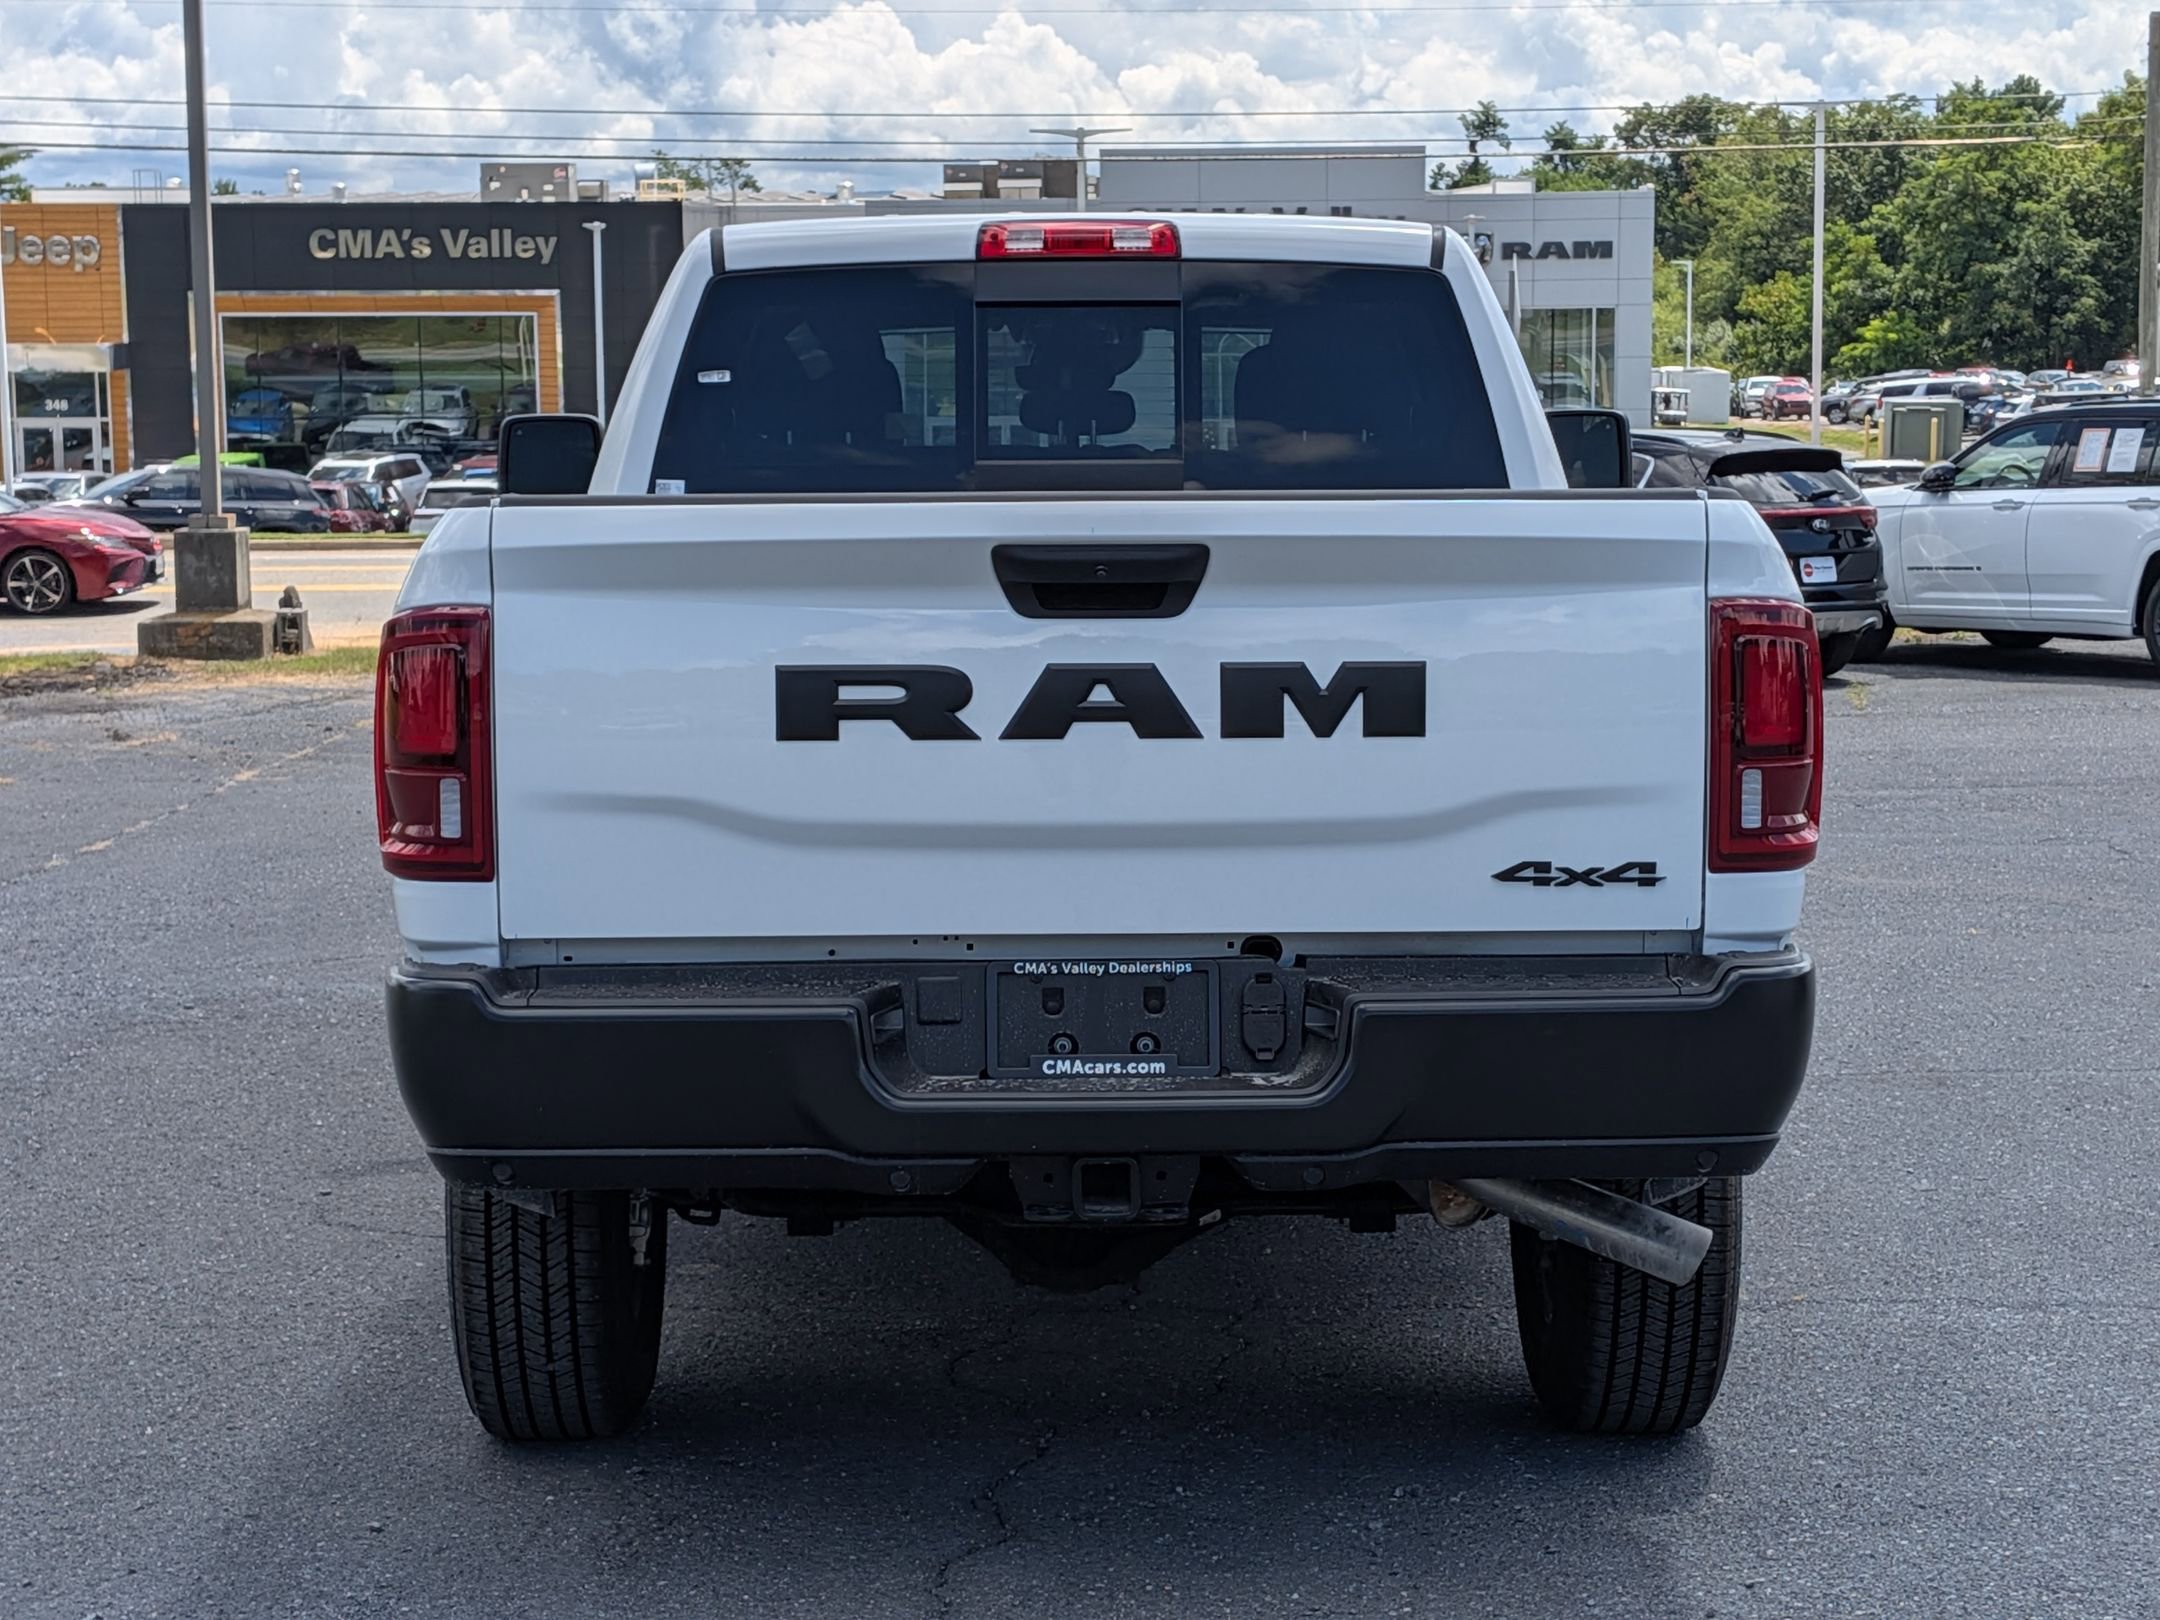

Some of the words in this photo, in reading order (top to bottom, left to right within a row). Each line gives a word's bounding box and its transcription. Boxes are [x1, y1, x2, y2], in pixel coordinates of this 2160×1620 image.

[308, 227, 432, 260] CMA's
[439, 227, 559, 265] Valley
[1501, 240, 1614, 261] RAM
[775, 660, 1427, 742] RAM
[1490, 860, 1668, 888] 4x4
[1013, 961, 1058, 975] CMA's
[1062, 961, 1105, 977] Valley
[1108, 960, 1193, 975] Dealerships
[1041, 1058, 1167, 1076] CMAcars.com
